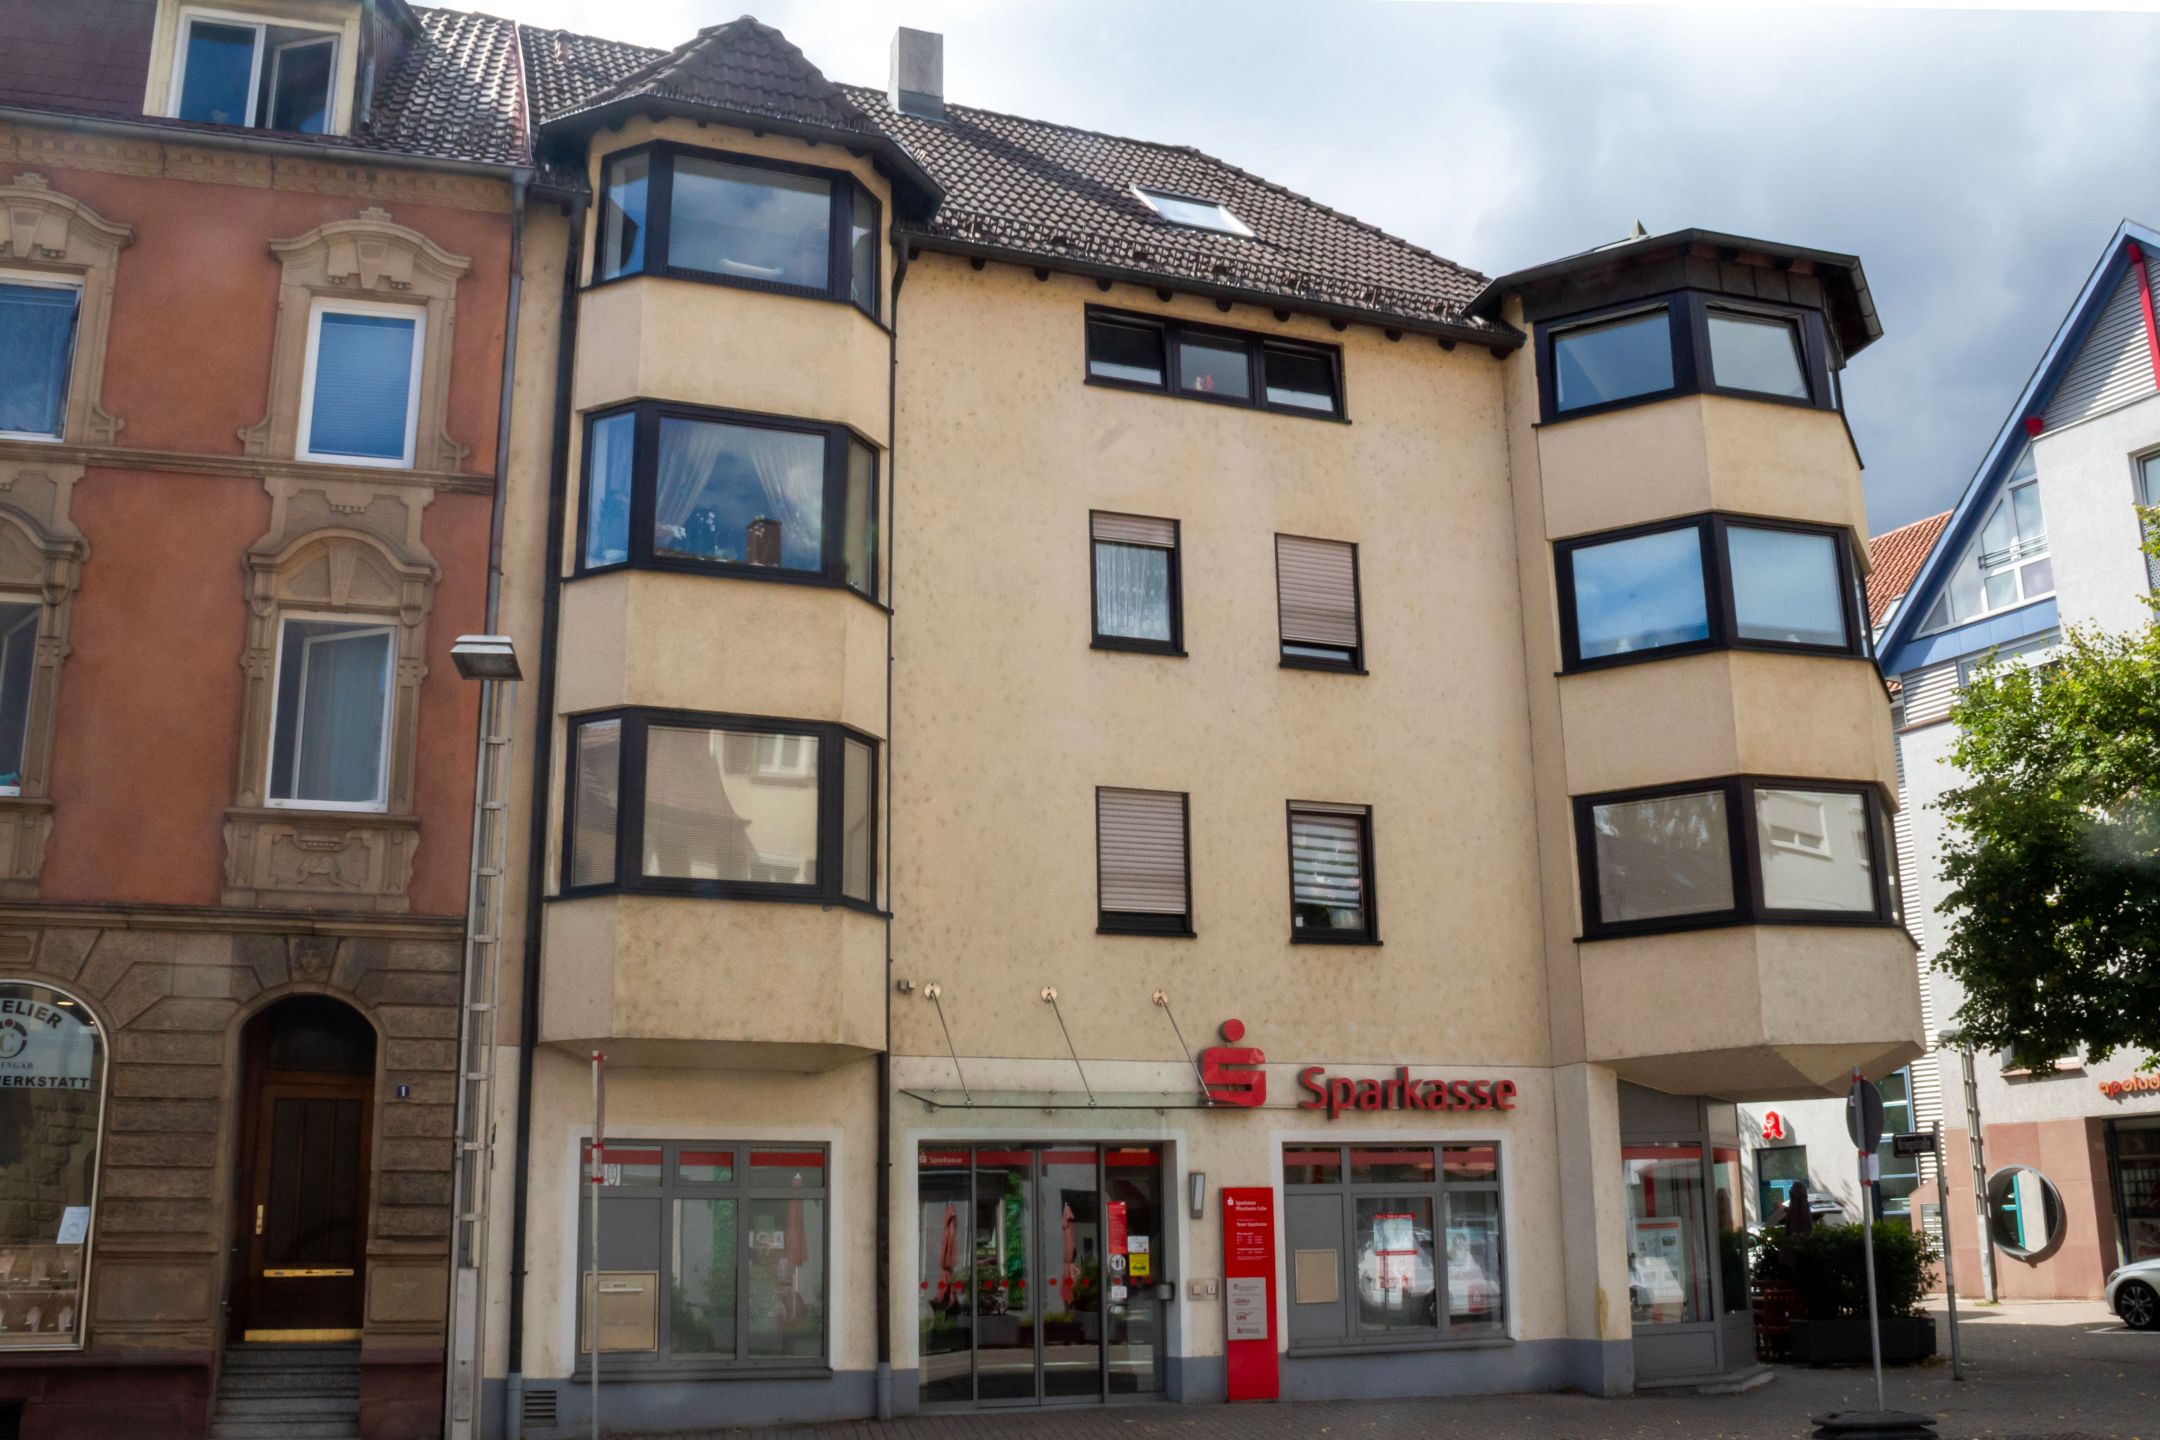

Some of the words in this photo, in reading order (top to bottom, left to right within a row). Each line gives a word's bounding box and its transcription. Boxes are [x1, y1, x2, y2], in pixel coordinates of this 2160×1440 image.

[0, 1076, 89, 1088] ERKSTATT
[1298, 1066, 1517, 1120] Sparkasse
[929, 1156, 962, 1164] Sparkasse
